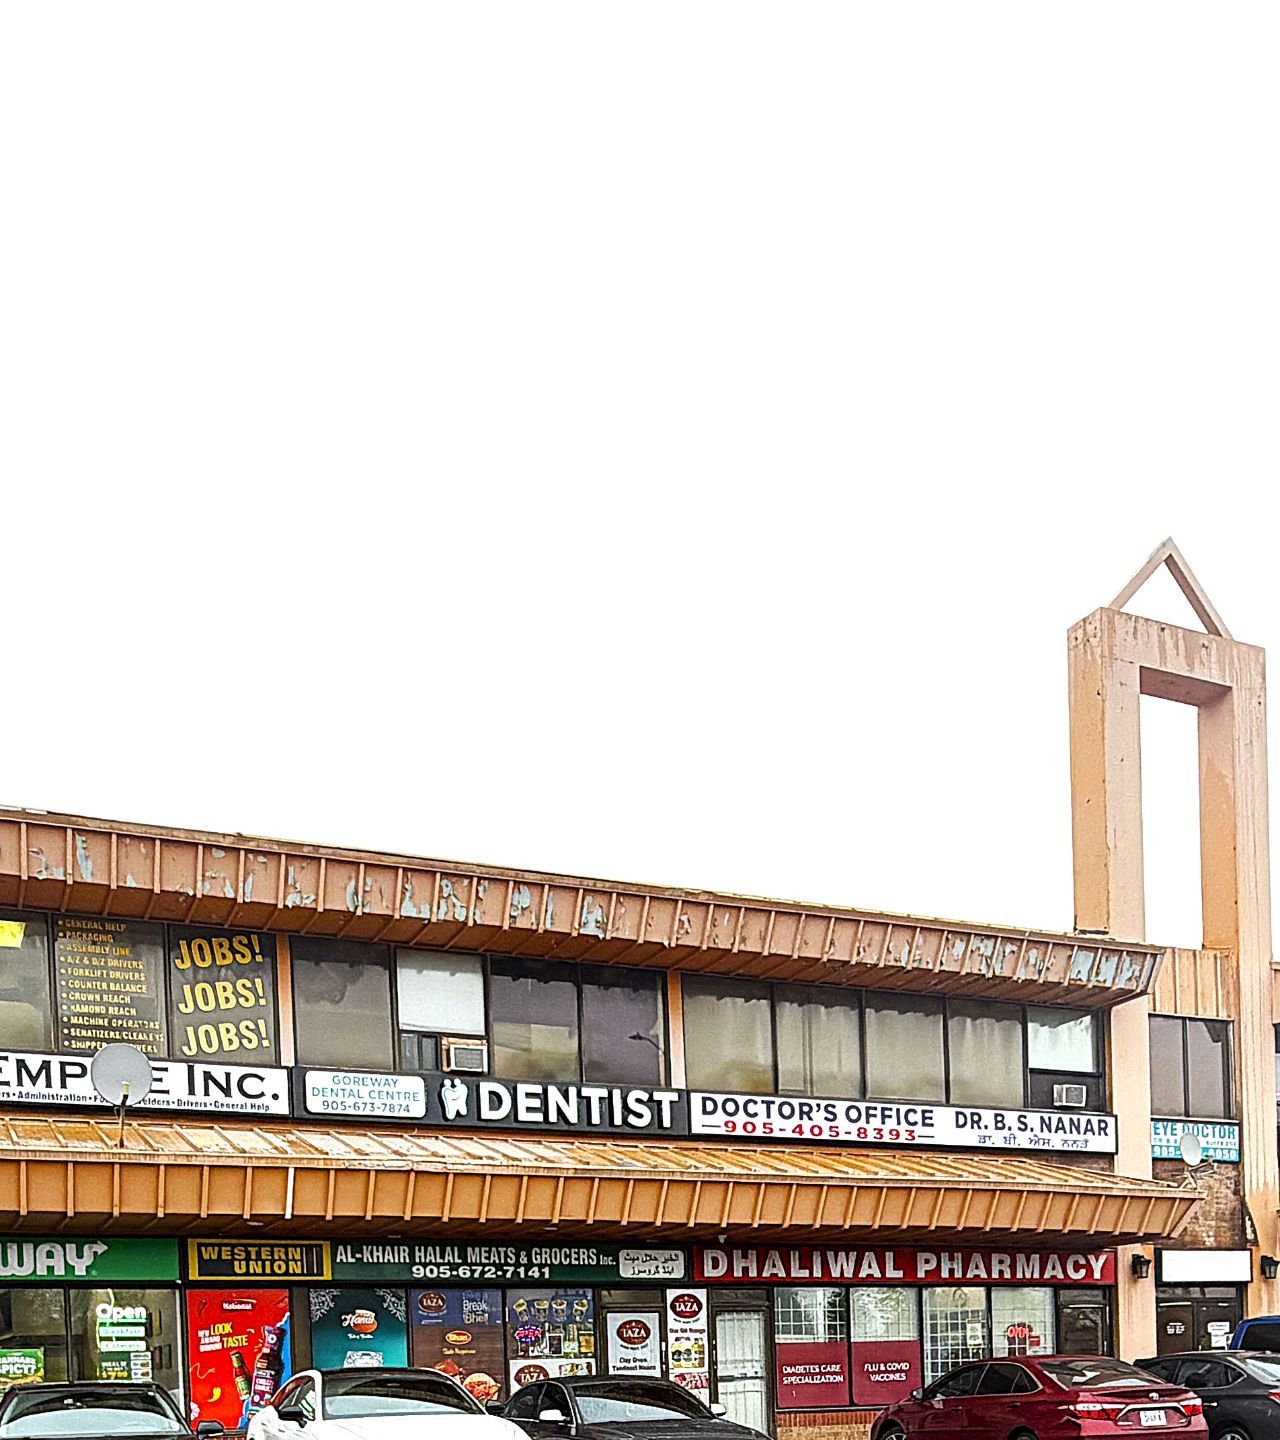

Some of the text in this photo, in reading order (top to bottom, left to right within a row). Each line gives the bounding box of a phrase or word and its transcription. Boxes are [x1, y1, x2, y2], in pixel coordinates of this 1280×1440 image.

[66, 931, 114, 943] PACKAGING
[66, 942, 110, 954] ASSEMBLY
[175, 935, 263, 970] JOBS!
[107, 958, 144, 969] DRIVERS
[68, 968, 146, 981] FORKLIFT DRIVERS
[68, 980, 147, 993] COUNTER BALANCE
[69, 991, 131, 1004] CROWN REACH
[178, 978, 266, 1014] JOBS!
[108, 1006, 137, 1016] REACH
[70, 1016, 109, 1027] MACHINE
[182, 1019, 270, 1056] JOBS!
[187, 1064, 280, 1101] INC.
[332, 1075, 399, 1088] GOREWAY
[312, 1087, 420, 1102] DENTAL CENTRE
[322, 1101, 410, 1113] 905-673-7874
[479, 1081, 679, 1128] DENTIST
[701, 1096, 935, 1127] DOCTOR'S OFFICE
[723, 1119, 916, 1142] 905-405-8393
[955, 1111, 1109, 1137] DR. B. S. NANAR
[1153, 1122, 1235, 1140] EYE DOCTOR
[201, 1246, 301, 1261] WESTERN
[336, 1245, 616, 1266] AL-KHAIR HALAL MEATS & GROCERS Inc.
[234, 1260, 302, 1274] UNION
[703, 1249, 1108, 1280] DHALIWAL PHARMACY
[411, 1266, 550, 1279] 905-672-7141
[222, 1301, 252, 1310] National
[422, 1298, 443, 1307] TAZA
[463, 1300, 488, 1312] Break
[674, 1302, 699, 1312] TAZA
[96, 1303, 147, 1323] Open
[210, 1321, 232, 1335] LOOK
[622, 1329, 646, 1338] TAZA
[222, 1334, 249, 1349] TASTE
[782, 1364, 842, 1374] DIABETES CARE
[864, 1363, 878, 1371] FLU
[886, 1362, 909, 1371] COVID
[782, 1373, 844, 1384] SPECIALIZATION
[870, 1372, 907, 1382] VACCINES
